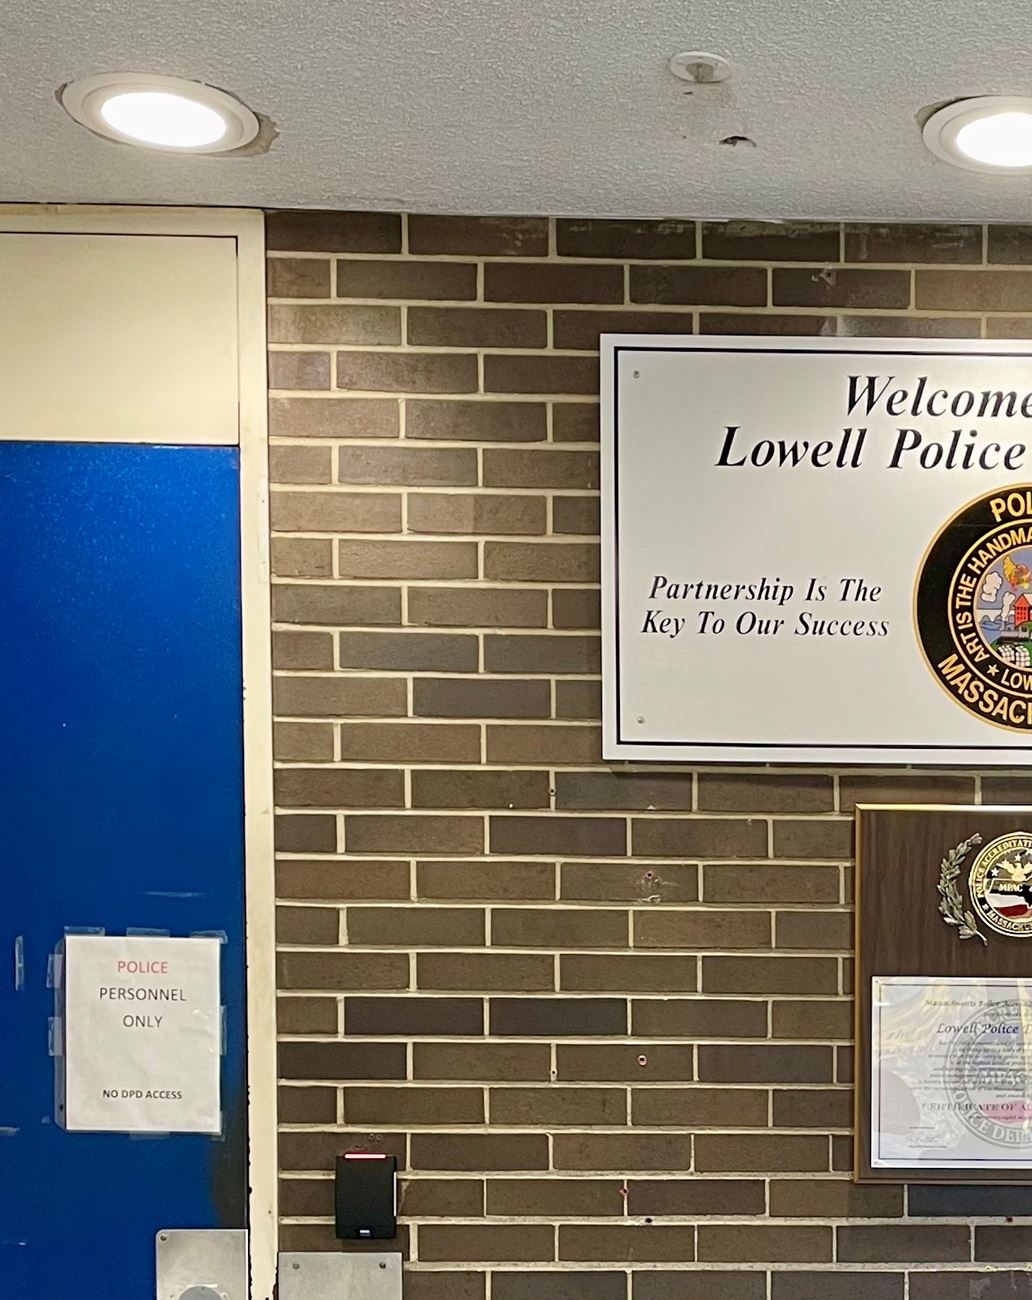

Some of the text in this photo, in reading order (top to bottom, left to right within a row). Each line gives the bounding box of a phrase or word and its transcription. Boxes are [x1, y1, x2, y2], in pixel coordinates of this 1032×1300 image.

[715, 427, 867, 468] Lowell
[888, 429, 1025, 470] Police
[649, 576, 881, 605] Partnership Is The
[955, 576, 977, 609] THE
[642, 611, 888, 638] Key To Our Success
[955, 612, 973, 631] IS
[961, 630, 991, 662] ART
[118, 961, 168, 973] POLICE
[100, 988, 186, 1001] PERSONNEL
[123, 1015, 162, 1027] ONLY
[935, 1022, 978, 1034] Lowell
[981, 1021, 1019, 1034] Police
[103, 1090, 182, 1099] NO DPD ACCESS
